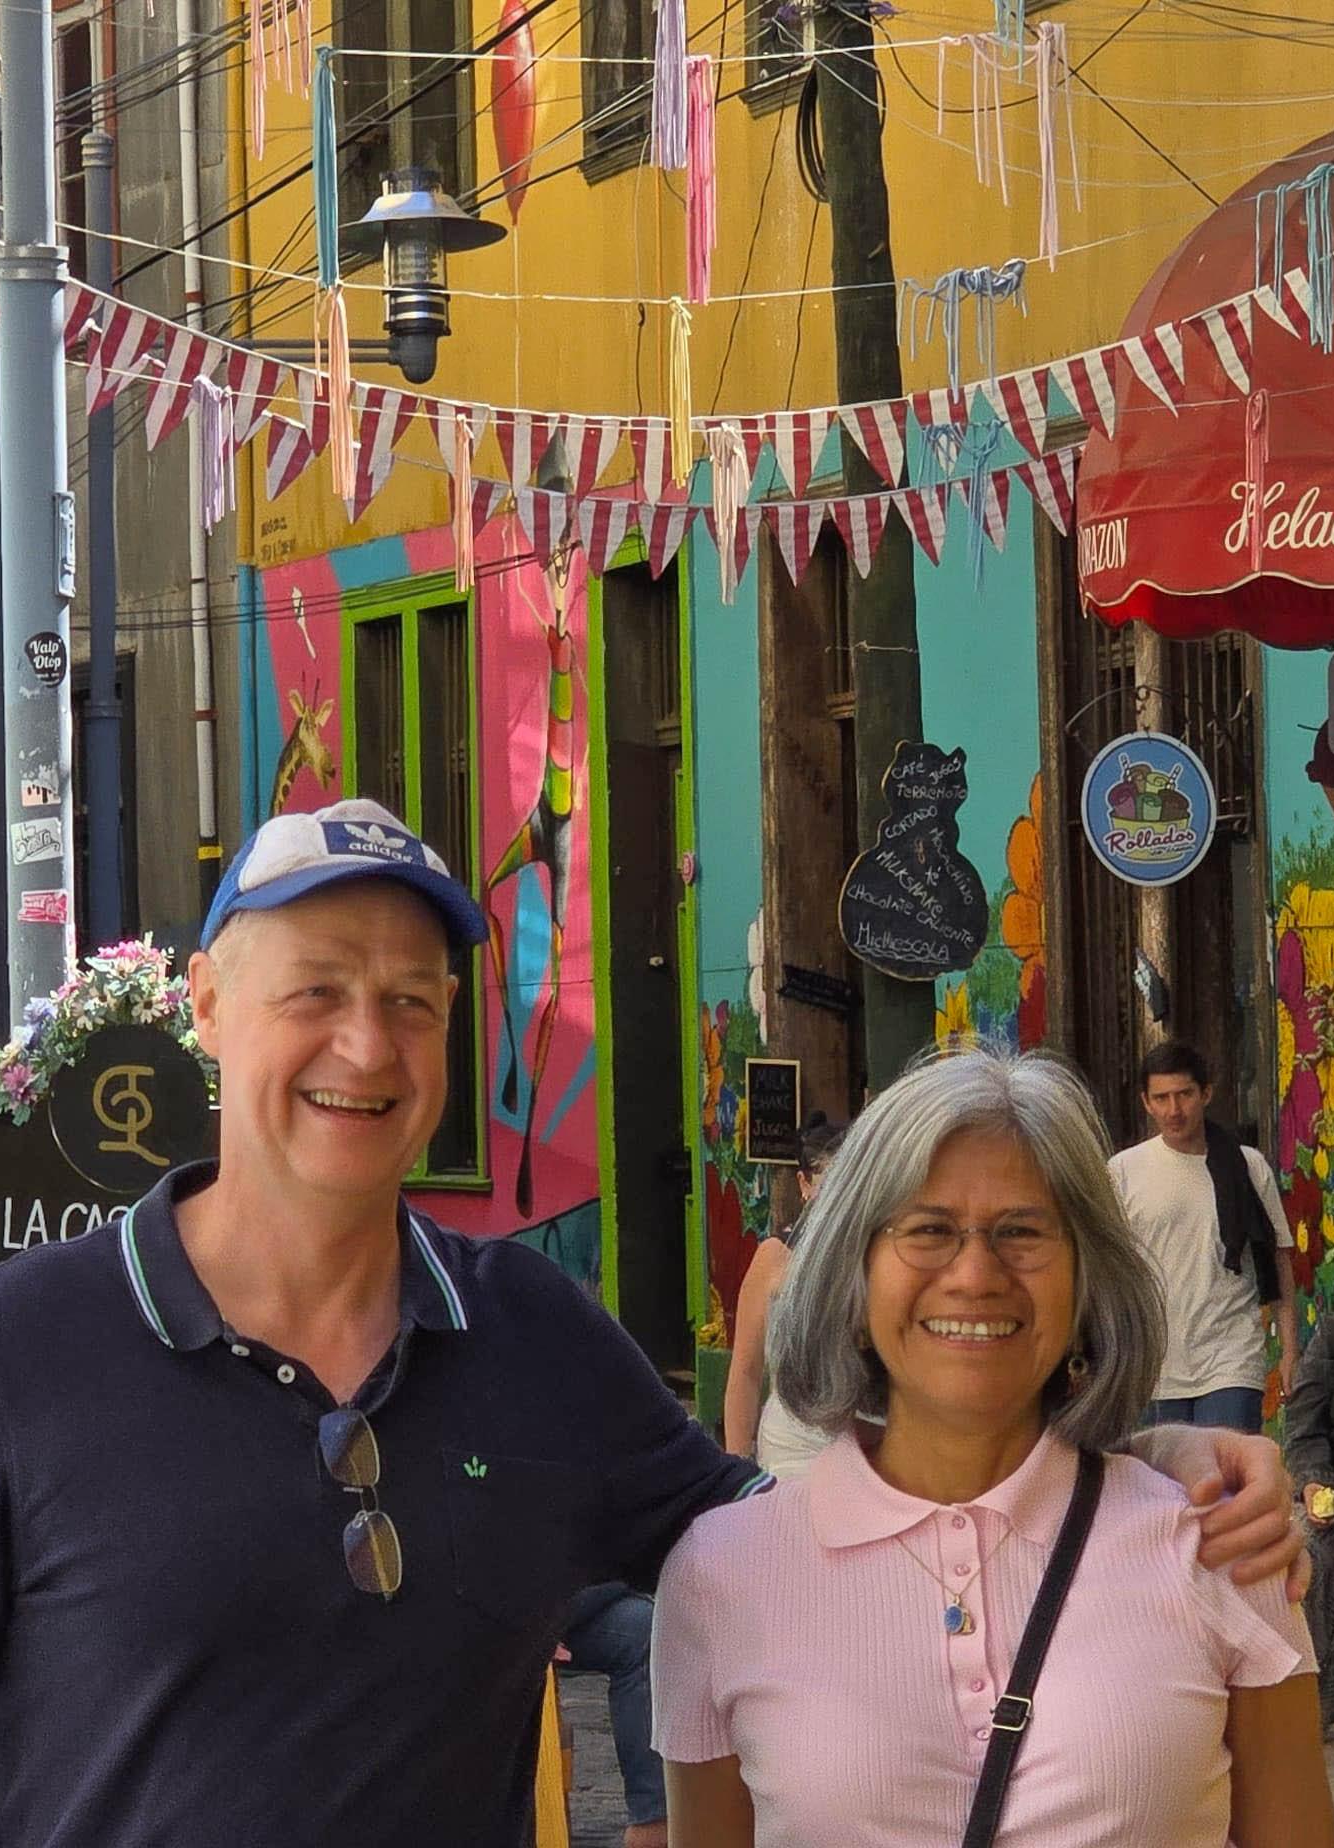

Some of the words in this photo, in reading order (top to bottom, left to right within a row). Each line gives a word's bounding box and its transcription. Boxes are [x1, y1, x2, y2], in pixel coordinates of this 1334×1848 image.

[1077, 518, 1129, 578] ORAZON
[885, 806, 938, 839] CORTADO
[348, 841, 413, 864] adidas
[1105, 827, 1195, 854] Rollados
[4, 1198, 49, 1250] LA
[60, 1202, 128, 1244] CA
